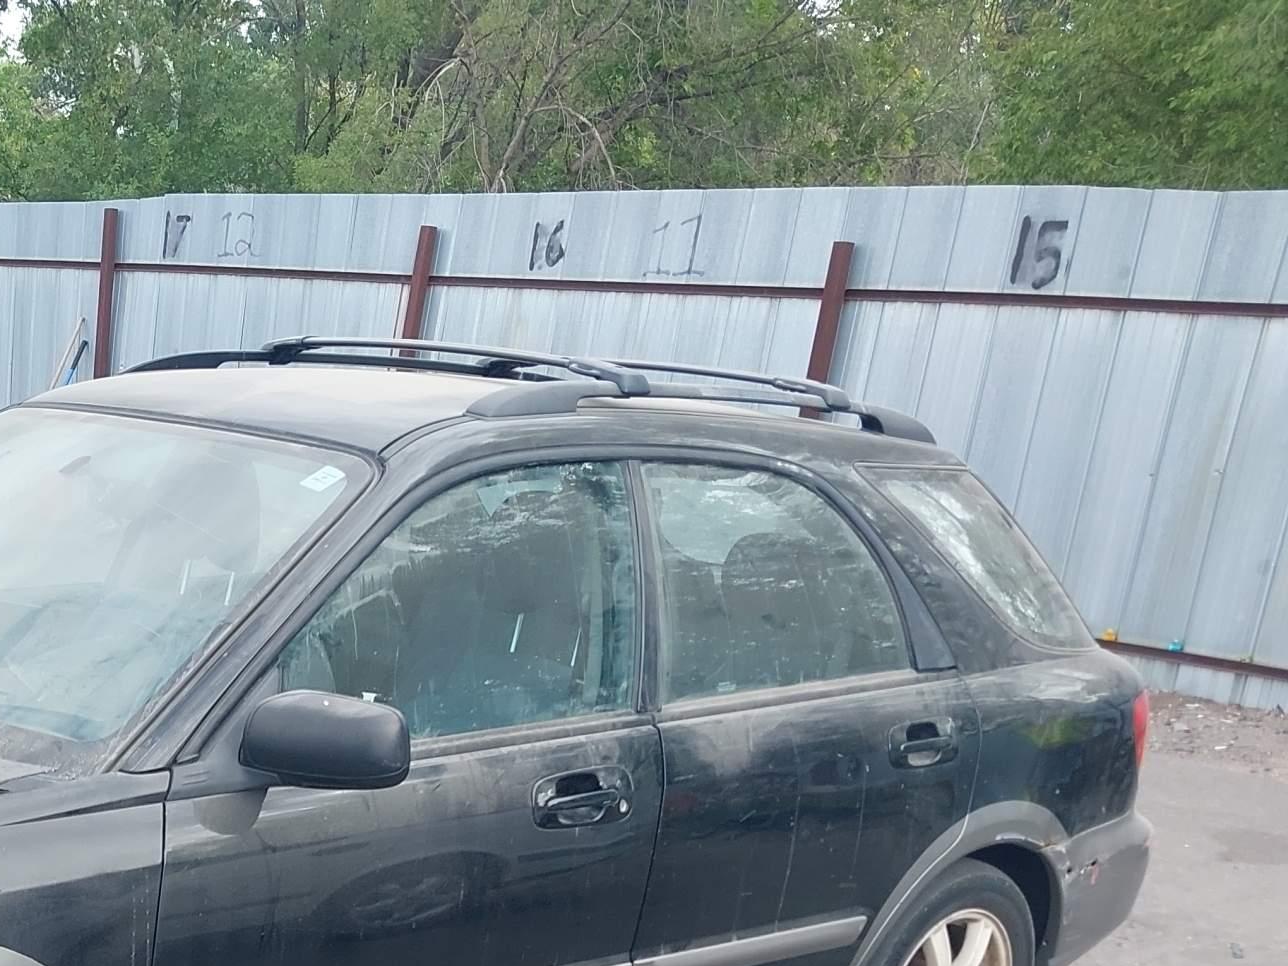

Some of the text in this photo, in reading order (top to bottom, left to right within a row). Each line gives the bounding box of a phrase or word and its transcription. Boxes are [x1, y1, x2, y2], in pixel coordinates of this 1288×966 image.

[162, 210, 191, 259] 17
[529, 219, 565, 272] 16
[642, 214, 705, 278] 11
[1009, 214, 1069, 290] 15
